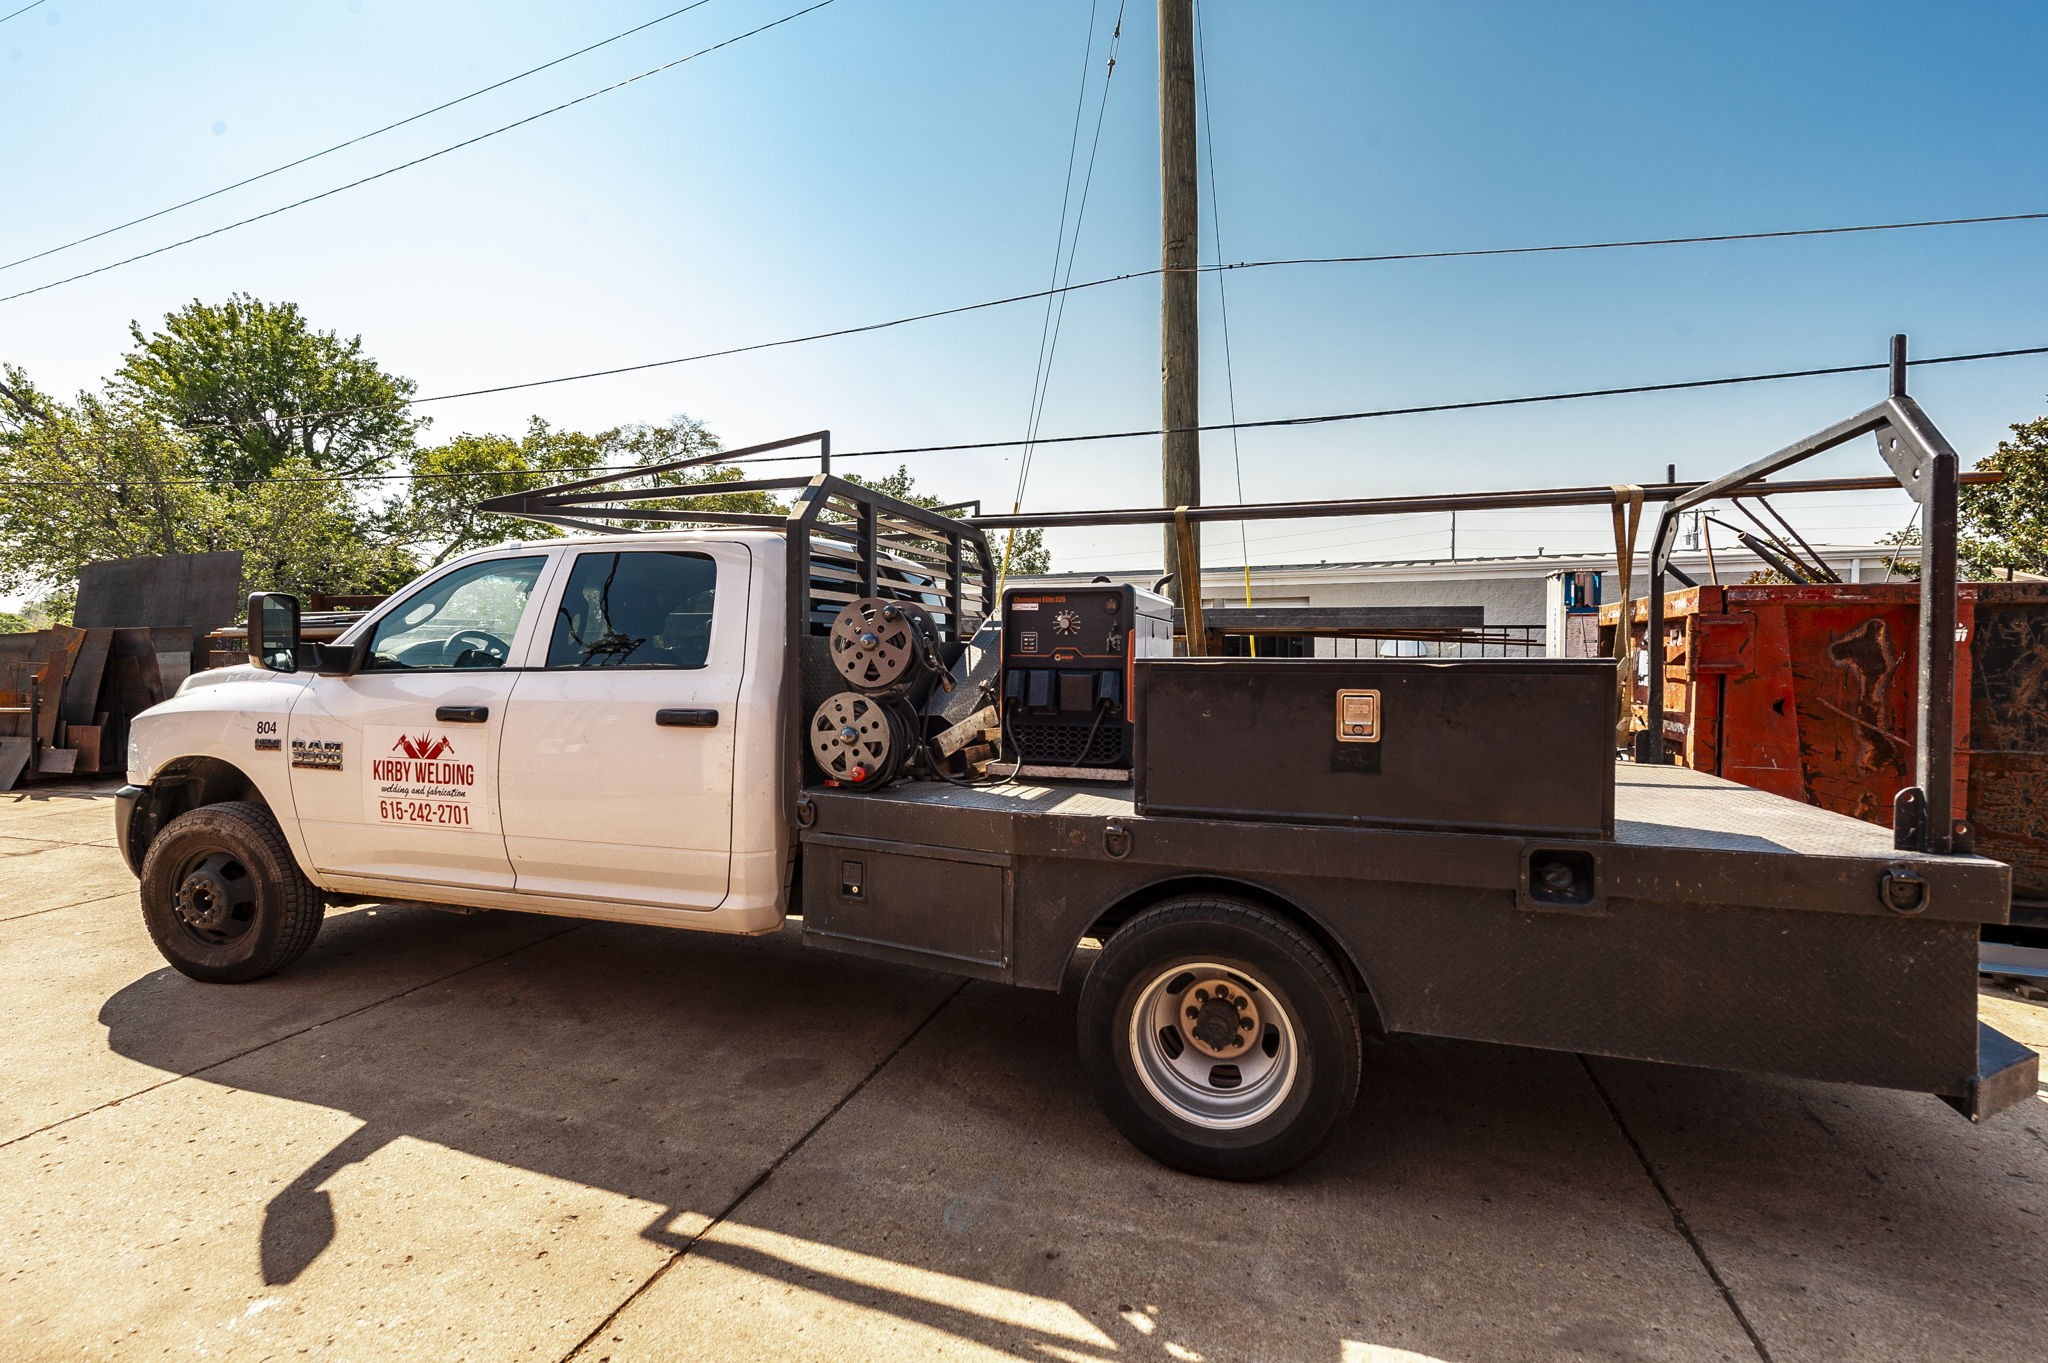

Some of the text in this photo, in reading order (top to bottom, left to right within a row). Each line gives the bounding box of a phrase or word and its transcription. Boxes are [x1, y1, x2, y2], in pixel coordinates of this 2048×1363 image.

[256, 721, 277, 734] 804
[292, 740, 343, 753] RAM
[292, 752, 343, 764] 3500
[373, 760, 474, 786] KIRBY WELDING
[381, 784, 466, 797] welding and fabrication
[380, 800, 469, 825] 615-242-2701
